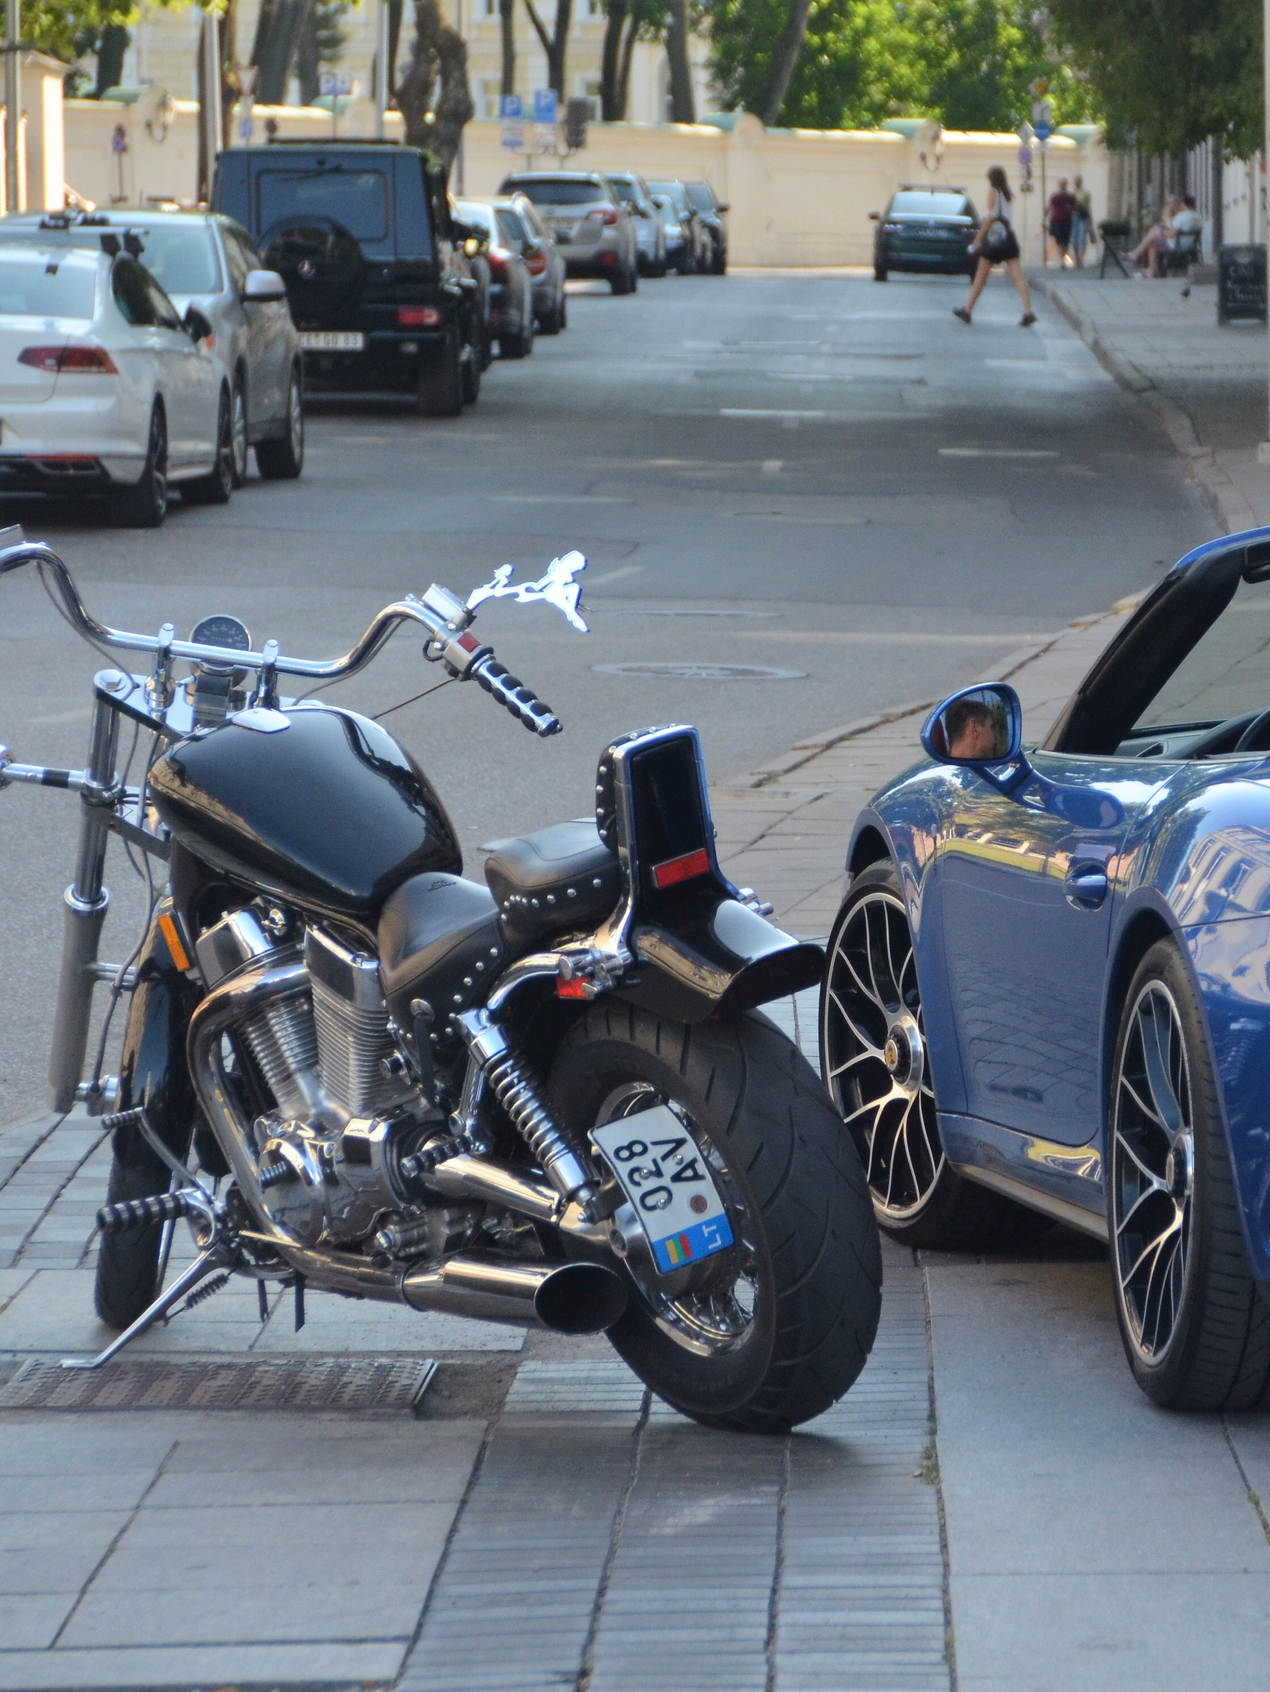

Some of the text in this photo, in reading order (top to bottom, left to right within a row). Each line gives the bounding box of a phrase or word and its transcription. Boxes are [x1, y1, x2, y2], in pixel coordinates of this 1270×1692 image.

[506, 97, 518, 113] P
[540, 90, 552, 107] P
[649, 1137, 707, 1185] AV
[613, 1139, 673, 1212] 028
[702, 1224, 722, 1250] LT
